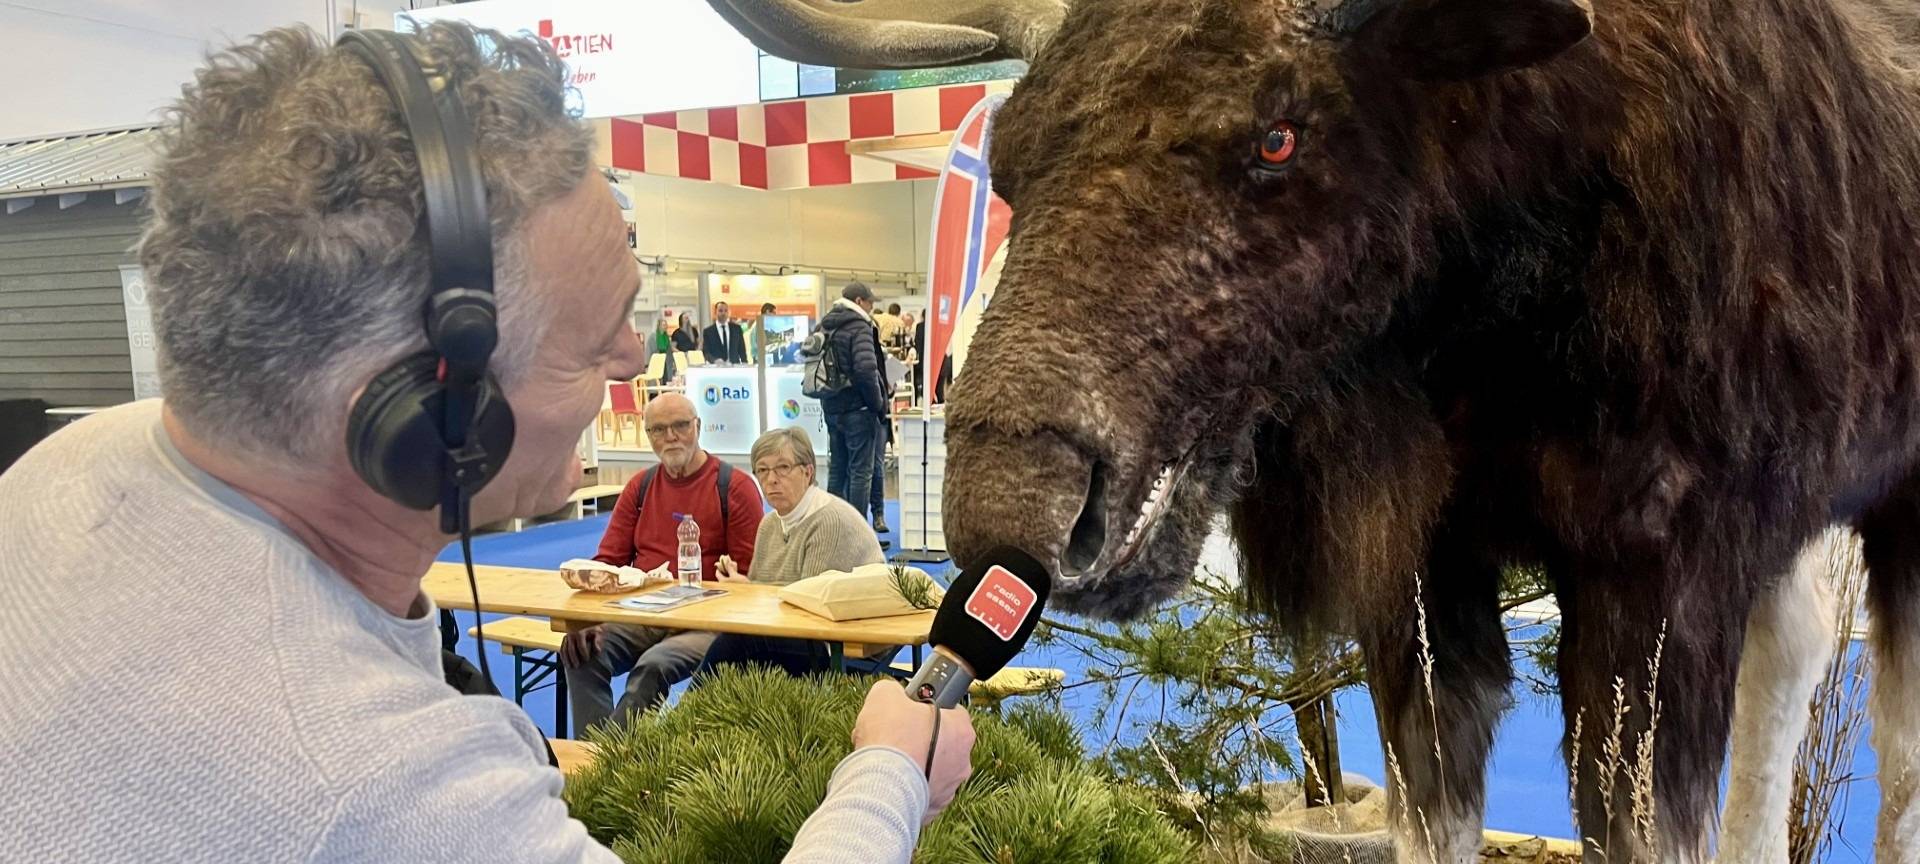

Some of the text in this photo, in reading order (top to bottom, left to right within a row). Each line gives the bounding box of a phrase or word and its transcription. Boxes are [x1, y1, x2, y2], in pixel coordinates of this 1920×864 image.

[554, 33, 612, 56] ATIEN
[570, 65, 596, 84] eben
[722, 386, 750, 400] Rab
[985, 591, 1017, 617] essen
[993, 583, 1021, 607] radio
